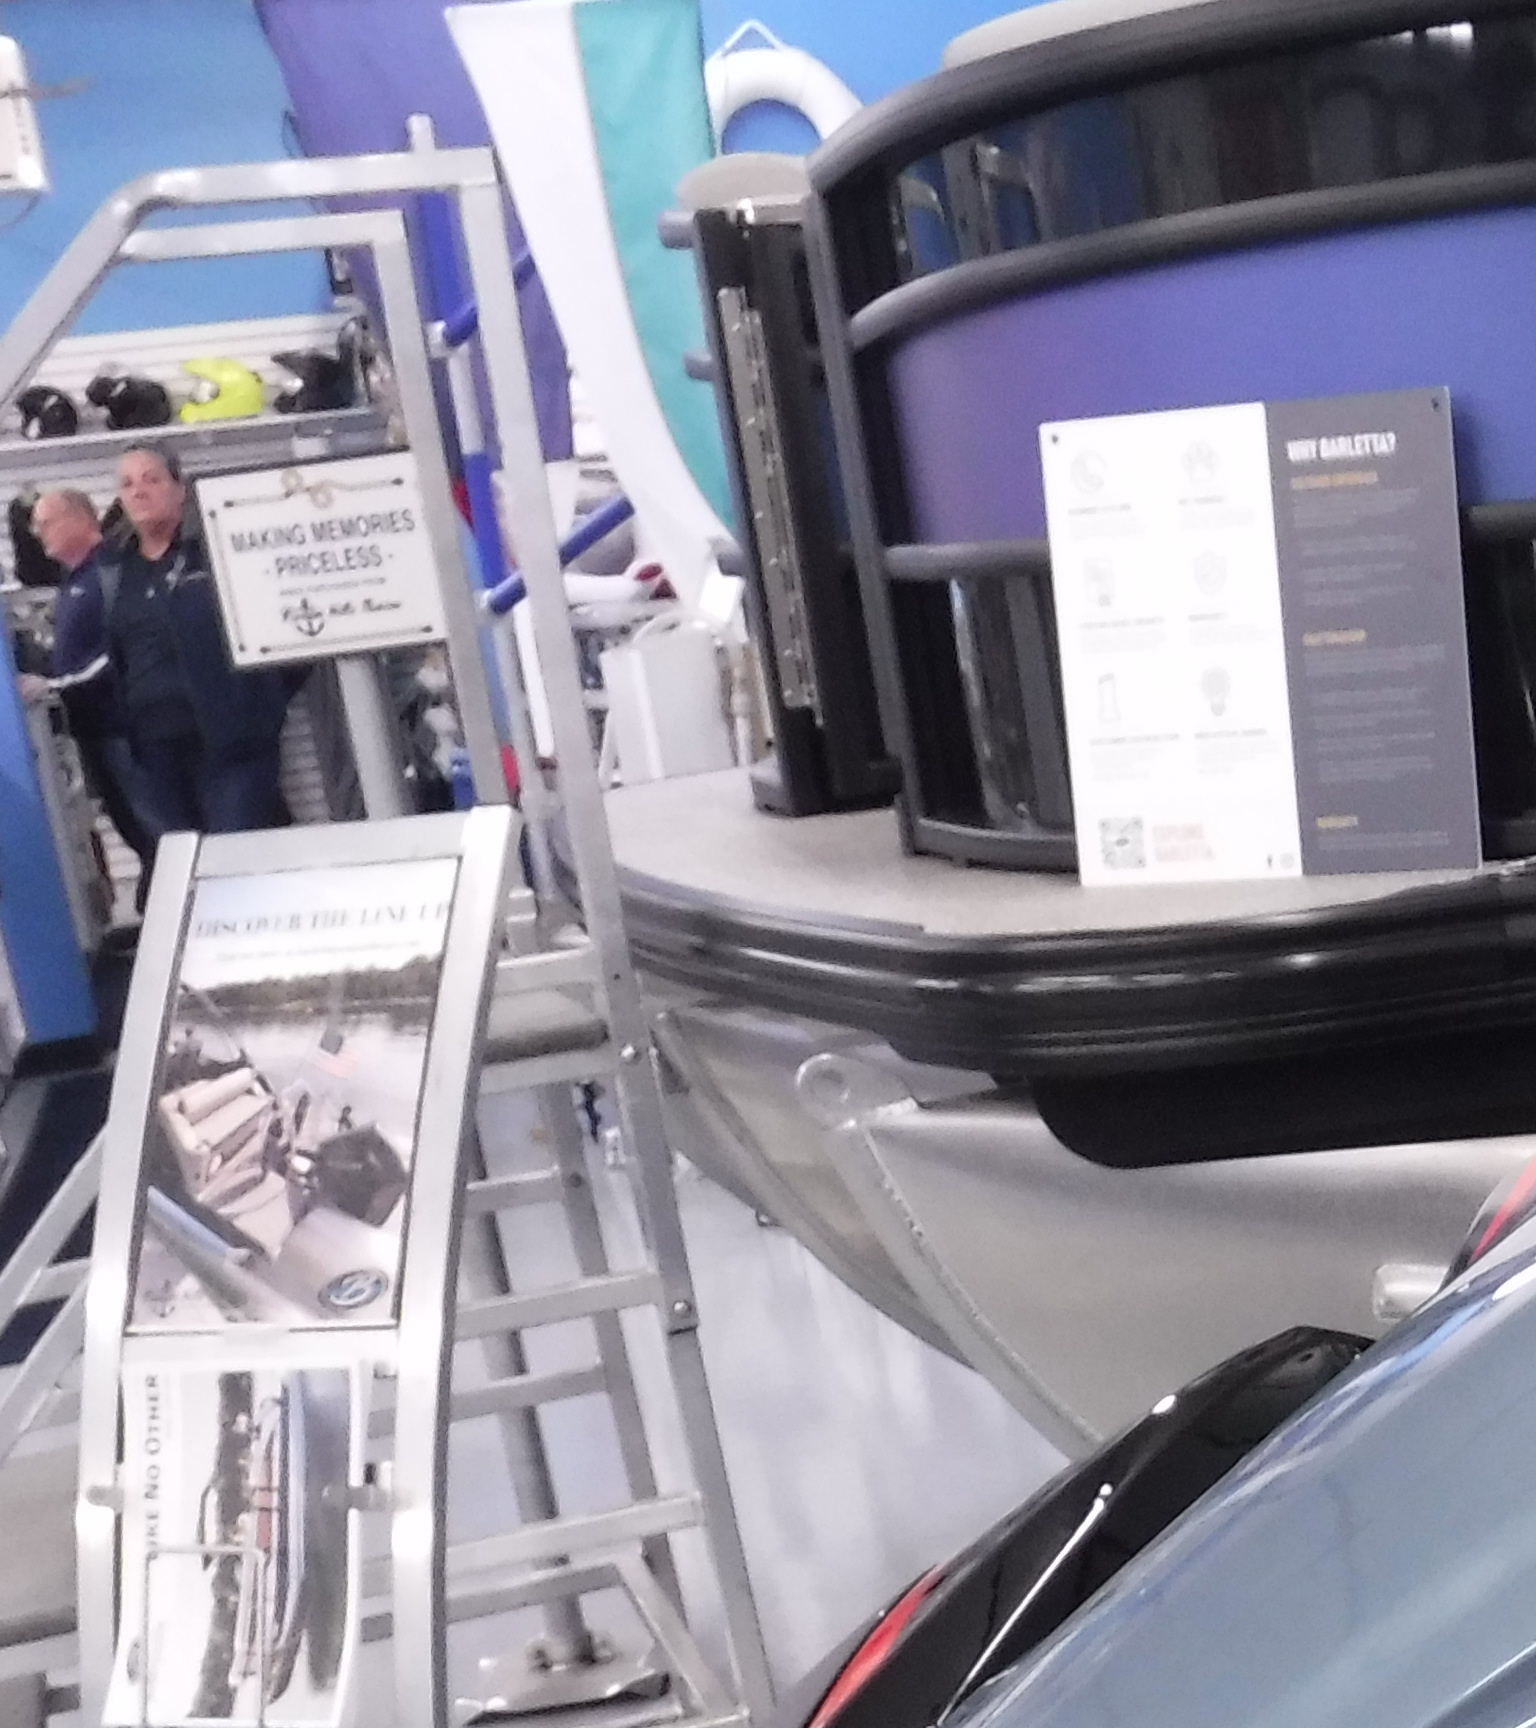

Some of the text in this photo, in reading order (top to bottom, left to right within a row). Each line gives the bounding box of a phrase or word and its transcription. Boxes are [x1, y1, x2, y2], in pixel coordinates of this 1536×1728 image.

[231, 509, 415, 552] MAKING MEMORIES
[275, 544, 383, 577] PRICELESS
[144, 1374, 161, 1456] OTHER
